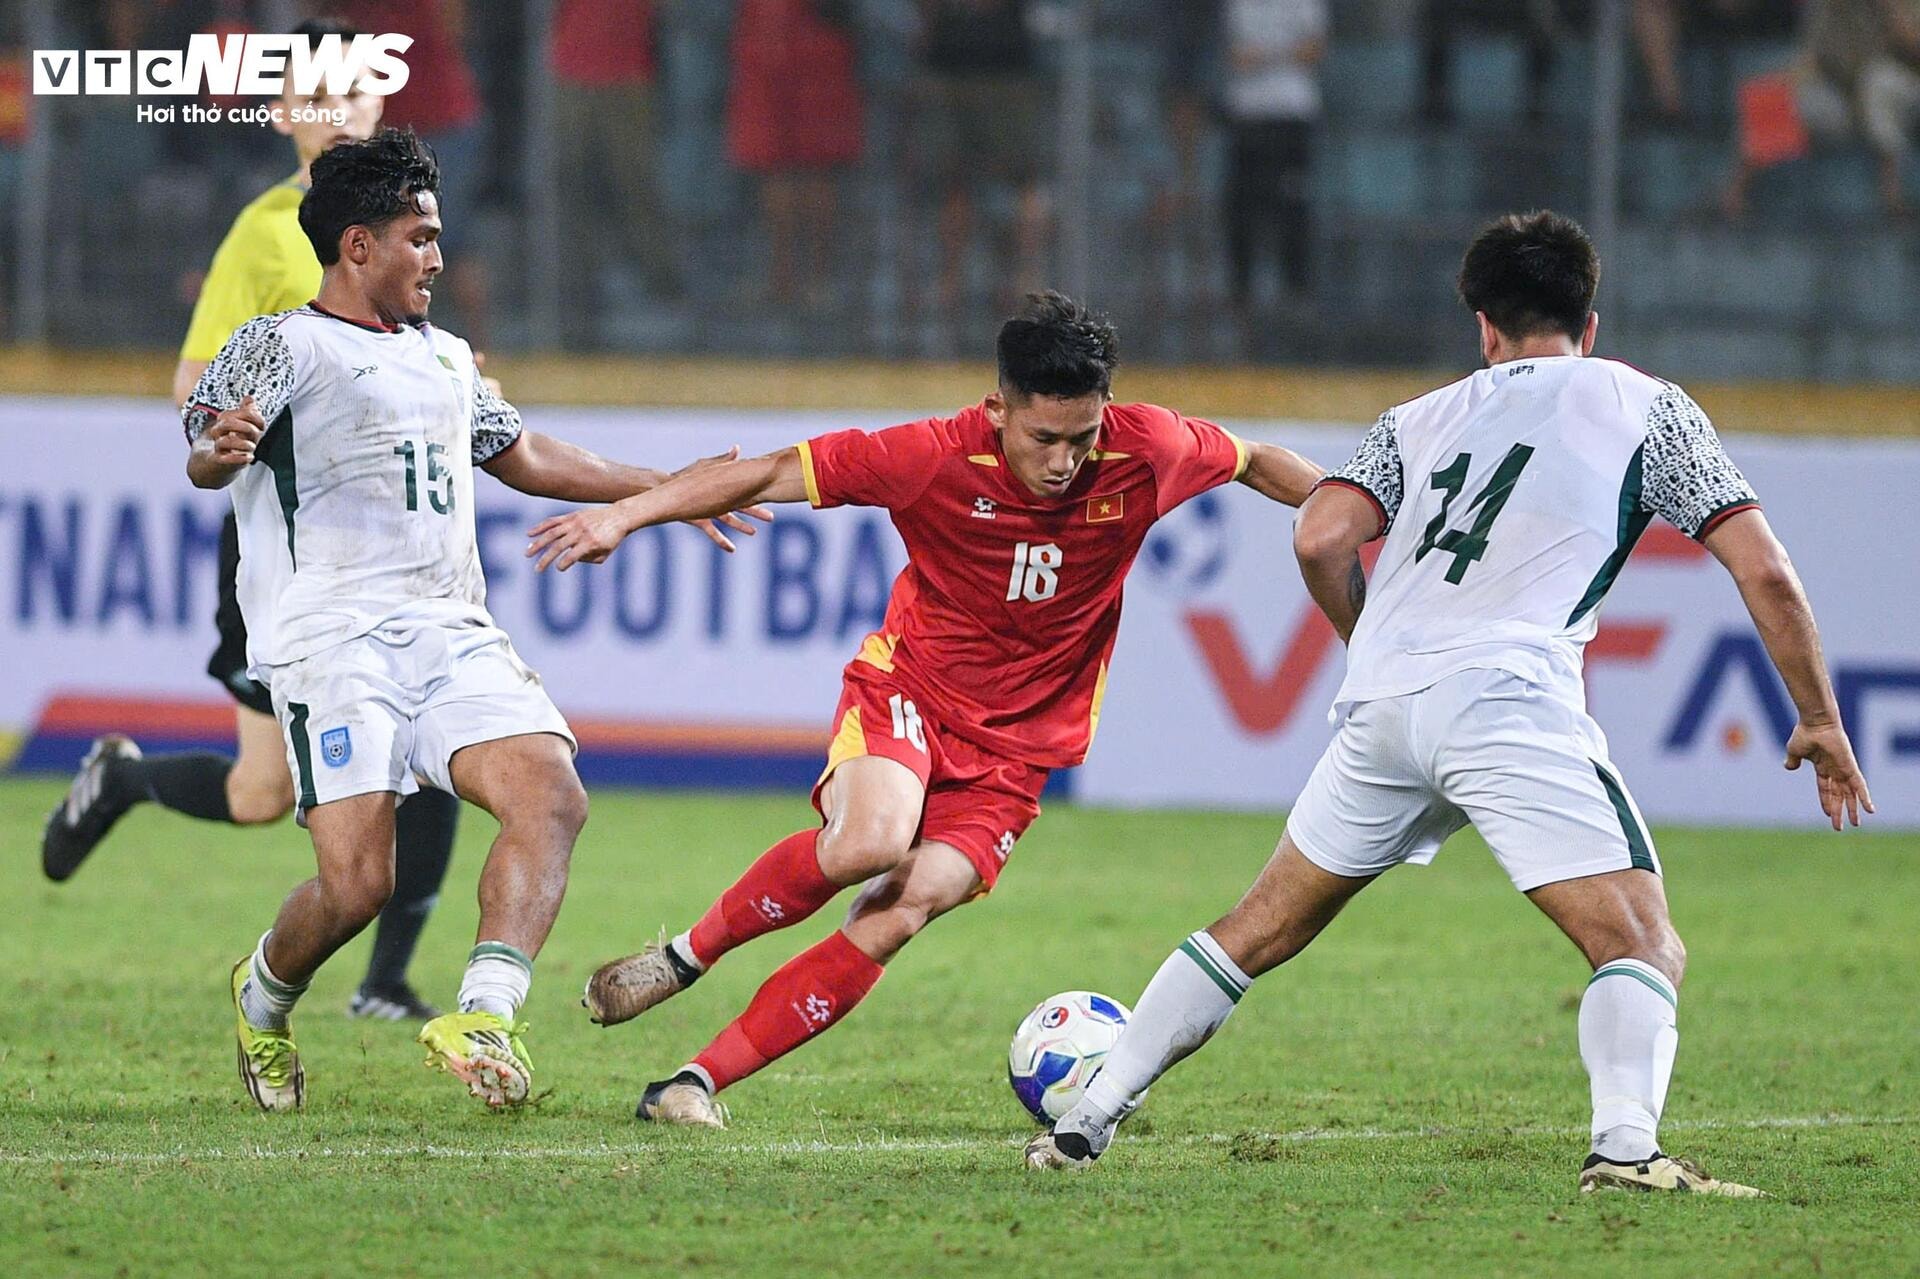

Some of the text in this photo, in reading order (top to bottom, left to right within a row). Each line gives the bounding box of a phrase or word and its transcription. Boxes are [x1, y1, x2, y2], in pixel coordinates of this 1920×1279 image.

[393, 440, 456, 516] 15
[1415, 442, 1536, 586] 14
[1006, 541, 1063, 603] 18
[888, 692, 928, 756] 18
